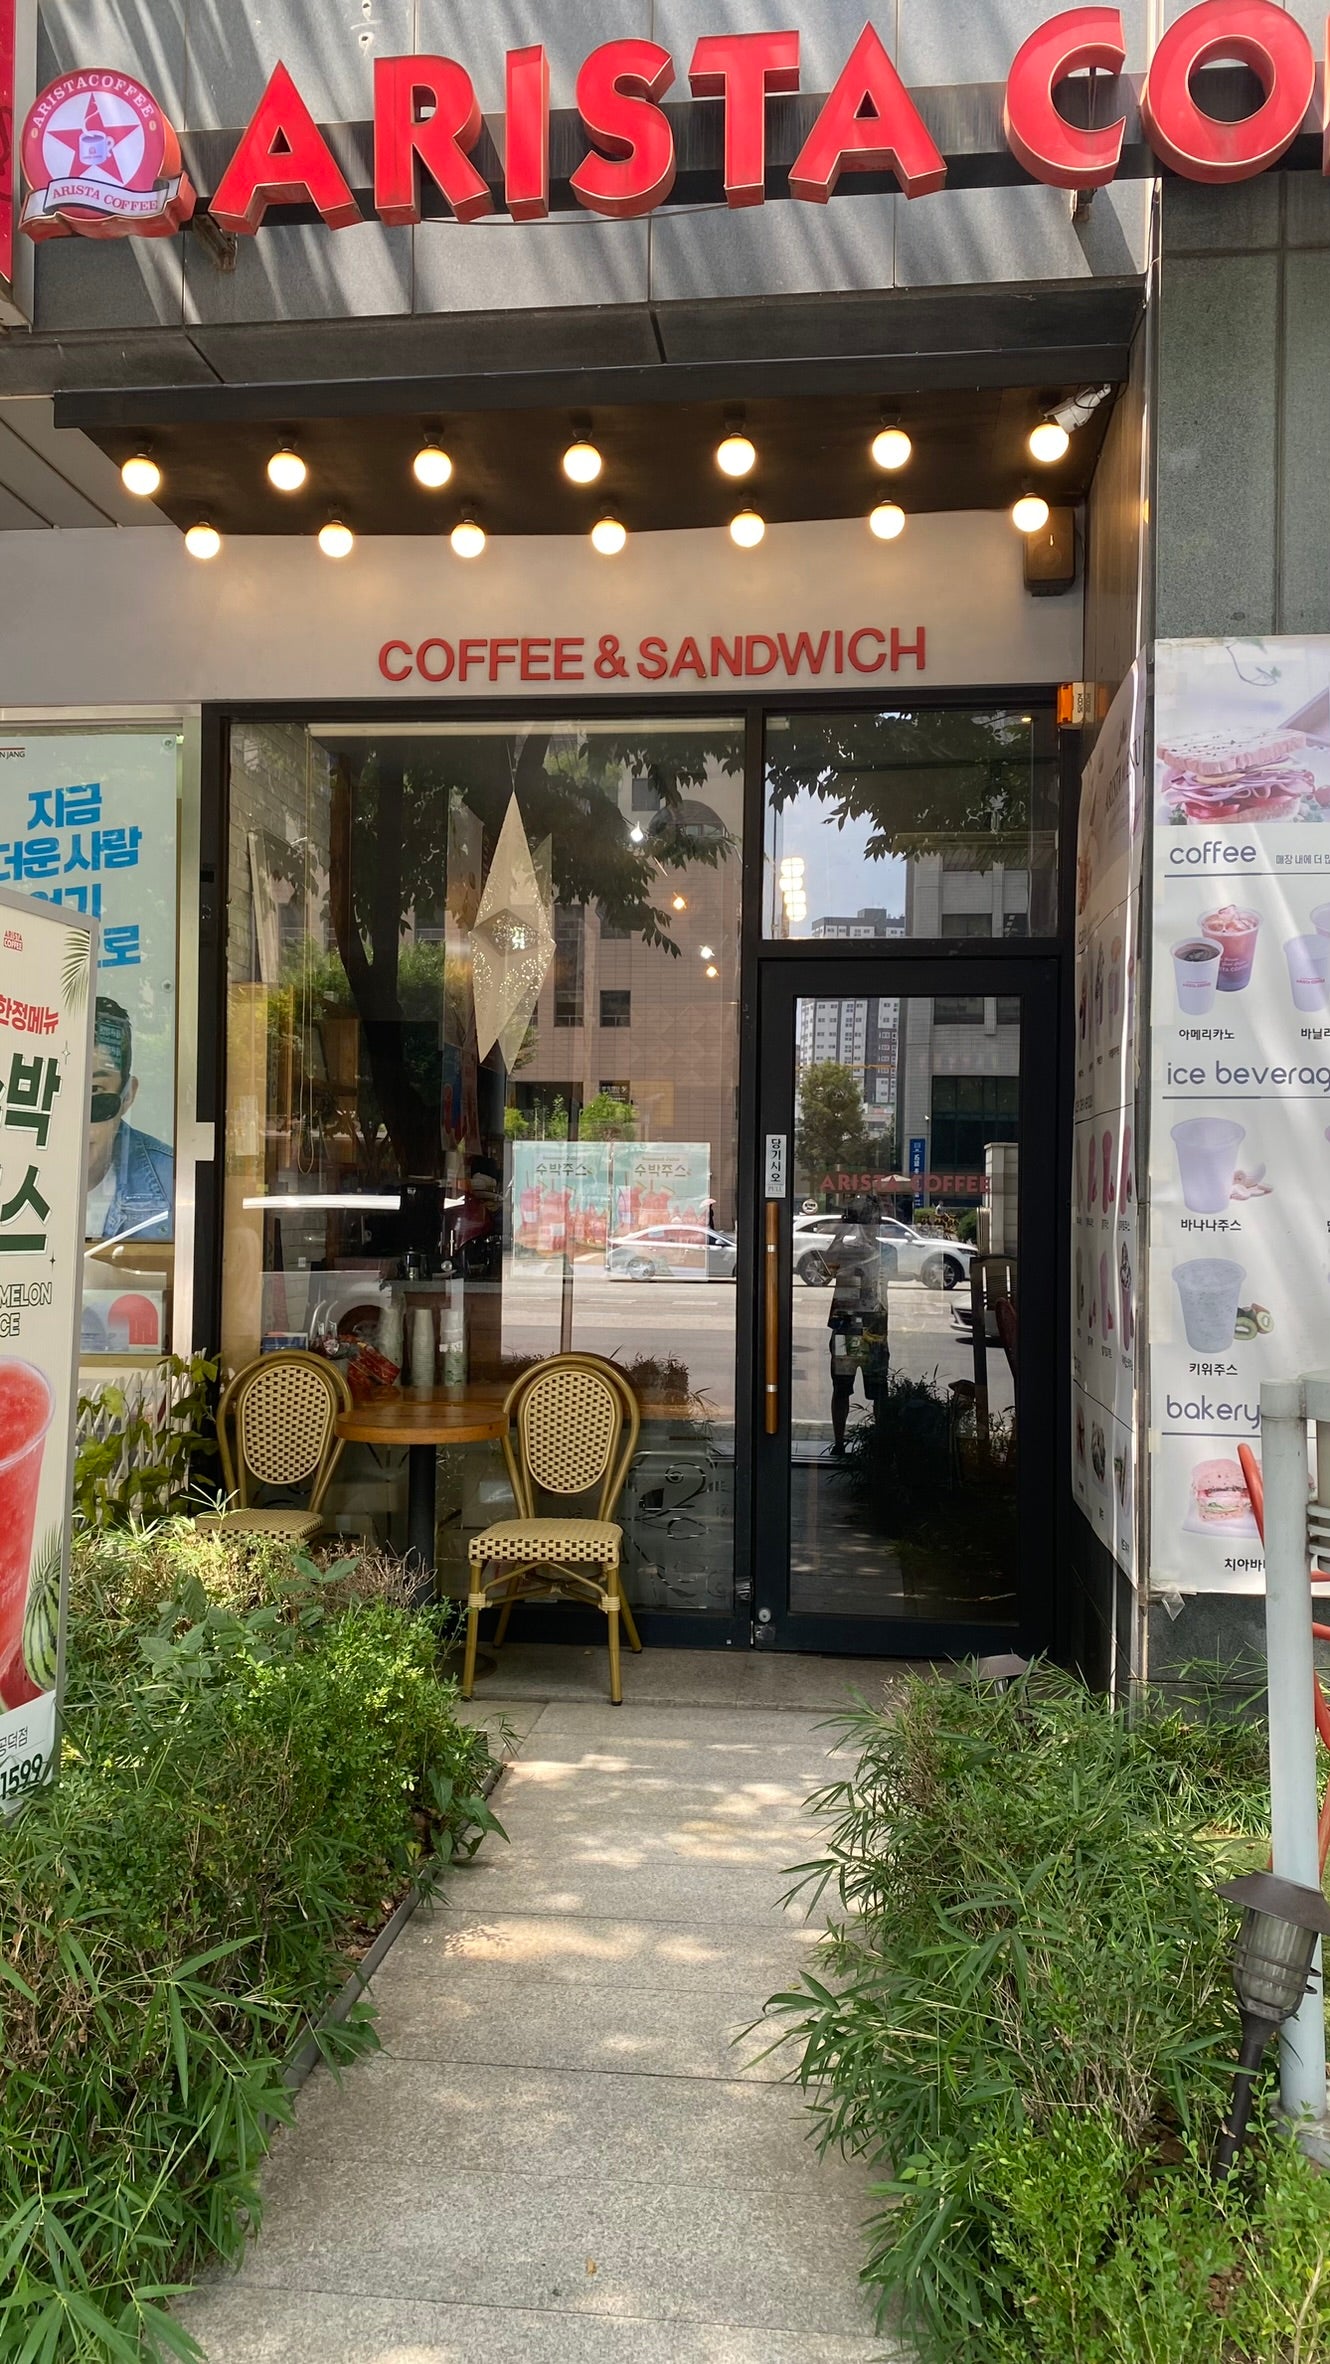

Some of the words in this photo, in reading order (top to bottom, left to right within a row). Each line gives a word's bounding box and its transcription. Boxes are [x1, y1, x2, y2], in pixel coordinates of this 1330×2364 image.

[208, 21, 947, 235] ARISTA
[1003, 0, 1330, 190] CO
[52, 184, 100, 200] ARISTA
[104, 194, 159, 212] COFFEE
[27, 783, 102, 830] 지금
[64, 826, 142, 873] 사람
[1170, 841, 1256, 864] coffee
[4, 929, 22, 941] ARISTA
[4, 938, 23, 951] COFFEE
[1179, 1029, 1235, 1041] 아메리카노
[1168, 1062, 1206, 1085] ice
[0, 1053, 60, 1150] 박
[536, 1163, 587, 1176] 수박주스
[634, 1163, 686, 1177] 수박주스
[770, 1138, 781, 1182] 당기시오
[820, 1174, 900, 1192] ARISTA
[911, 1174, 990, 1193] COFFEE
[1181, 1219, 1242, 1232] 바나나주스
[1189, 1363, 1238, 1376] 키위주스
[1167, 1394, 1260, 1430] bakery
[1224, 1558, 1265, 1572] 치아바
[0, 1754, 43, 1800] 1599
